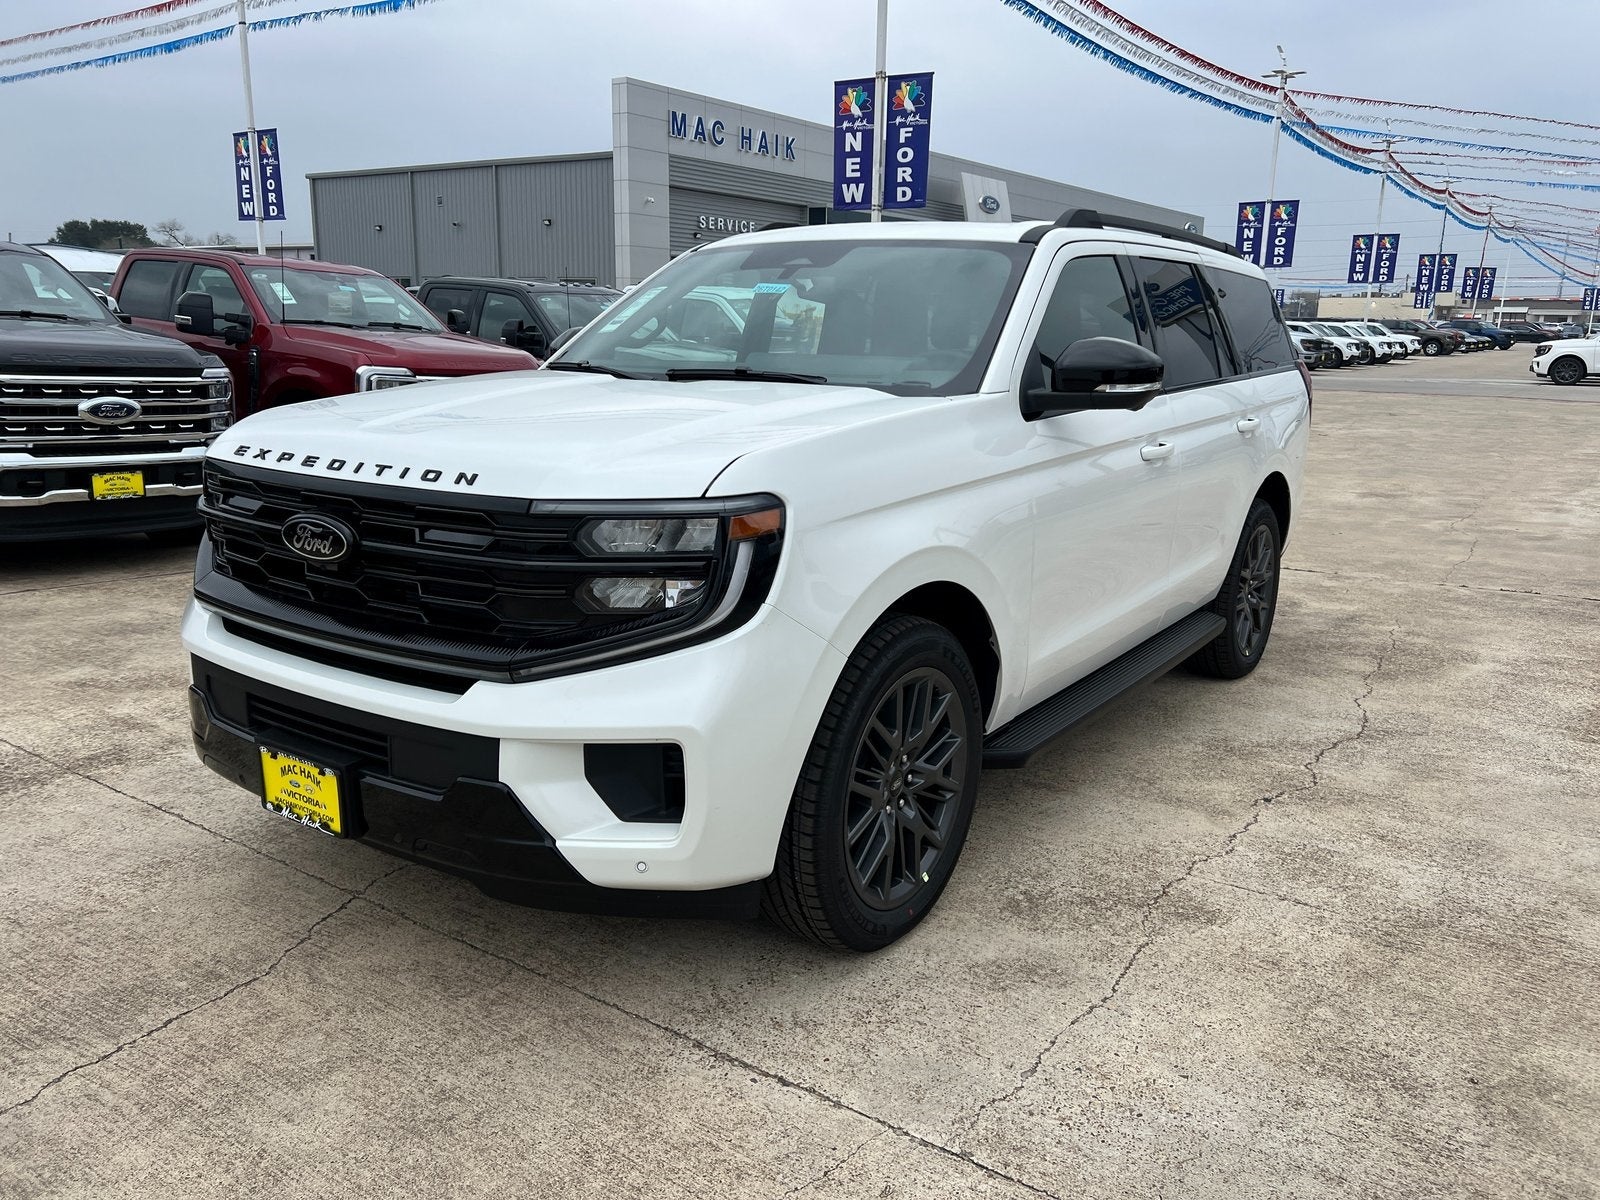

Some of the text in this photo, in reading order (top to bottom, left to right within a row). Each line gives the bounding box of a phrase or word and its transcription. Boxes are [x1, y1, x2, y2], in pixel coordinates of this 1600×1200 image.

[670, 110, 796, 161] MAC HAIK
[842, 131, 865, 203] NEW
[896, 127, 914, 202] FORD
[241, 167, 253, 216] NEW
[266, 166, 277, 216] FORD
[699, 215, 756, 233] SERVICE
[1241, 228, 1255, 263] NEW
[1273, 227, 1287, 265] FORD
[1352, 253, 1365, 281] NEW
[1378, 253, 1390, 282] FORD
[1419, 269, 1430, 291] NEW
[1440, 269, 1450, 291] FORD
[1464, 280, 1473, 298] NEW
[1481, 280, 1490, 298] FORD
[98, 404, 127, 418] Ford
[233, 445, 479, 486] EXPEDITION
[293, 523, 334, 555] Ford
[280, 765, 297, 777] MAC
[300, 766, 322, 791] HAIK
[285, 789, 321, 808] VICTORIA
[280, 806, 323, 829] Mac Haik
